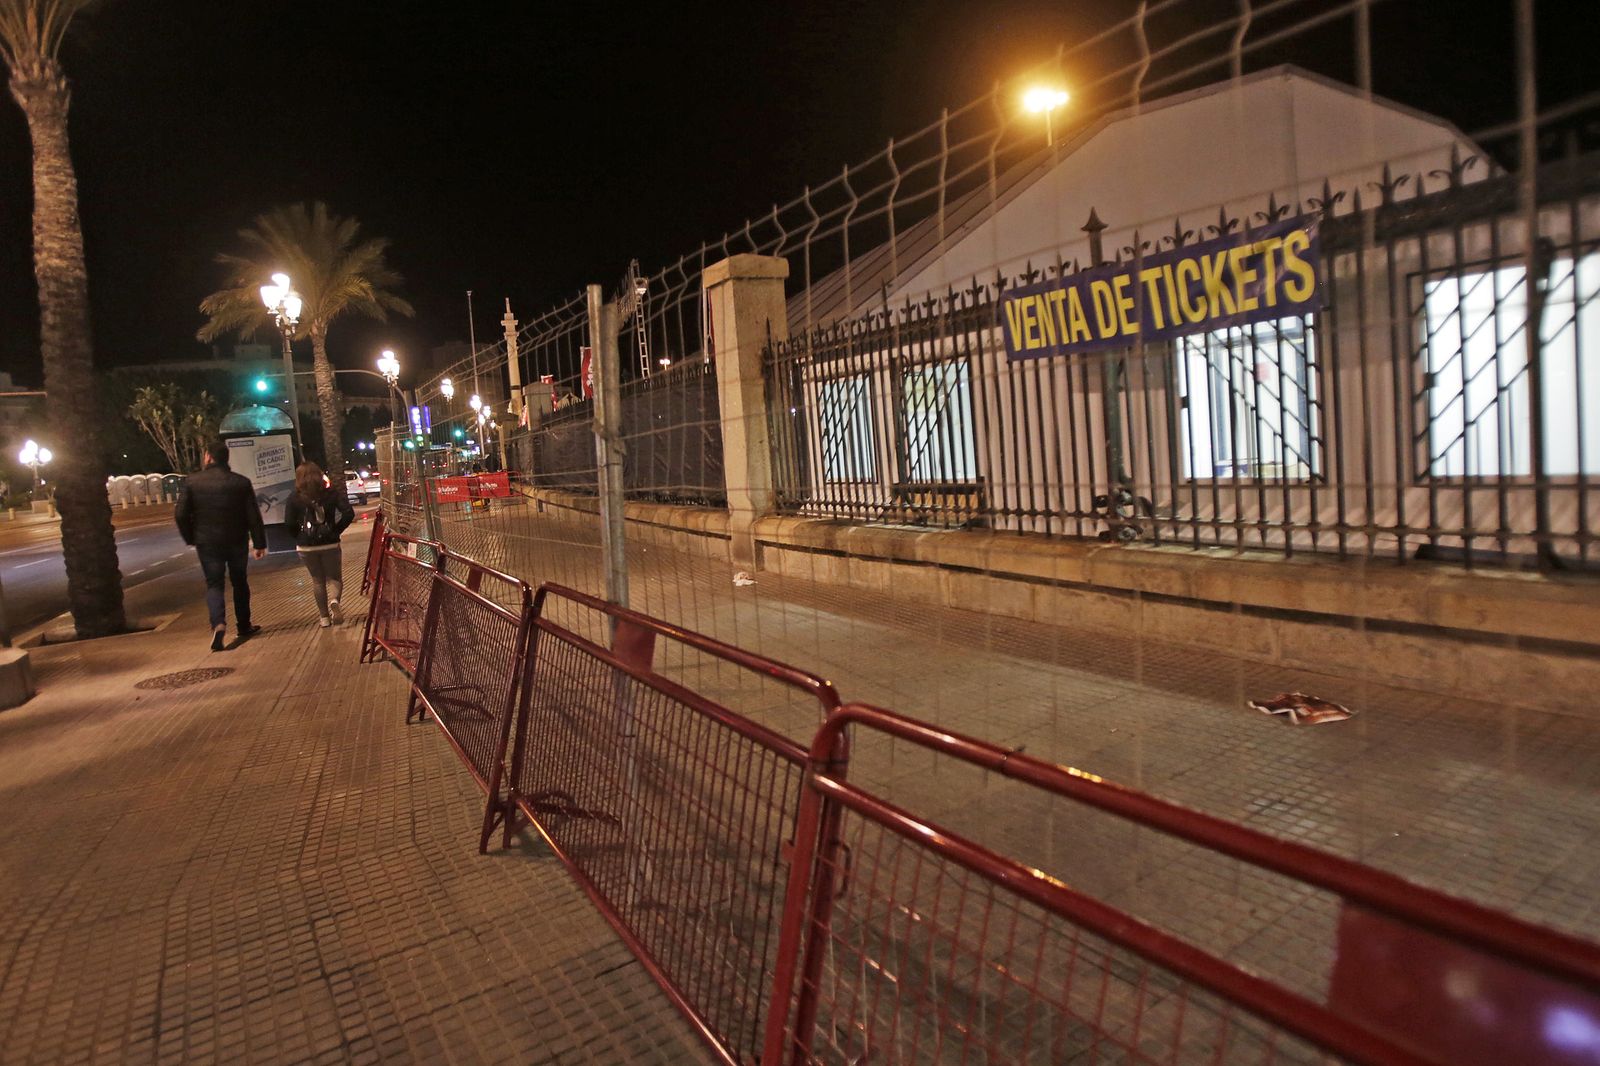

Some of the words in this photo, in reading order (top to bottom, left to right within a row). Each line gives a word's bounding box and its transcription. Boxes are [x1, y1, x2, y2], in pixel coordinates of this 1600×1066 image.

[1005, 286, 1092, 352] VENTA
[1090, 273, 1140, 340] DE
[1139, 229, 1315, 331] TICKETS
